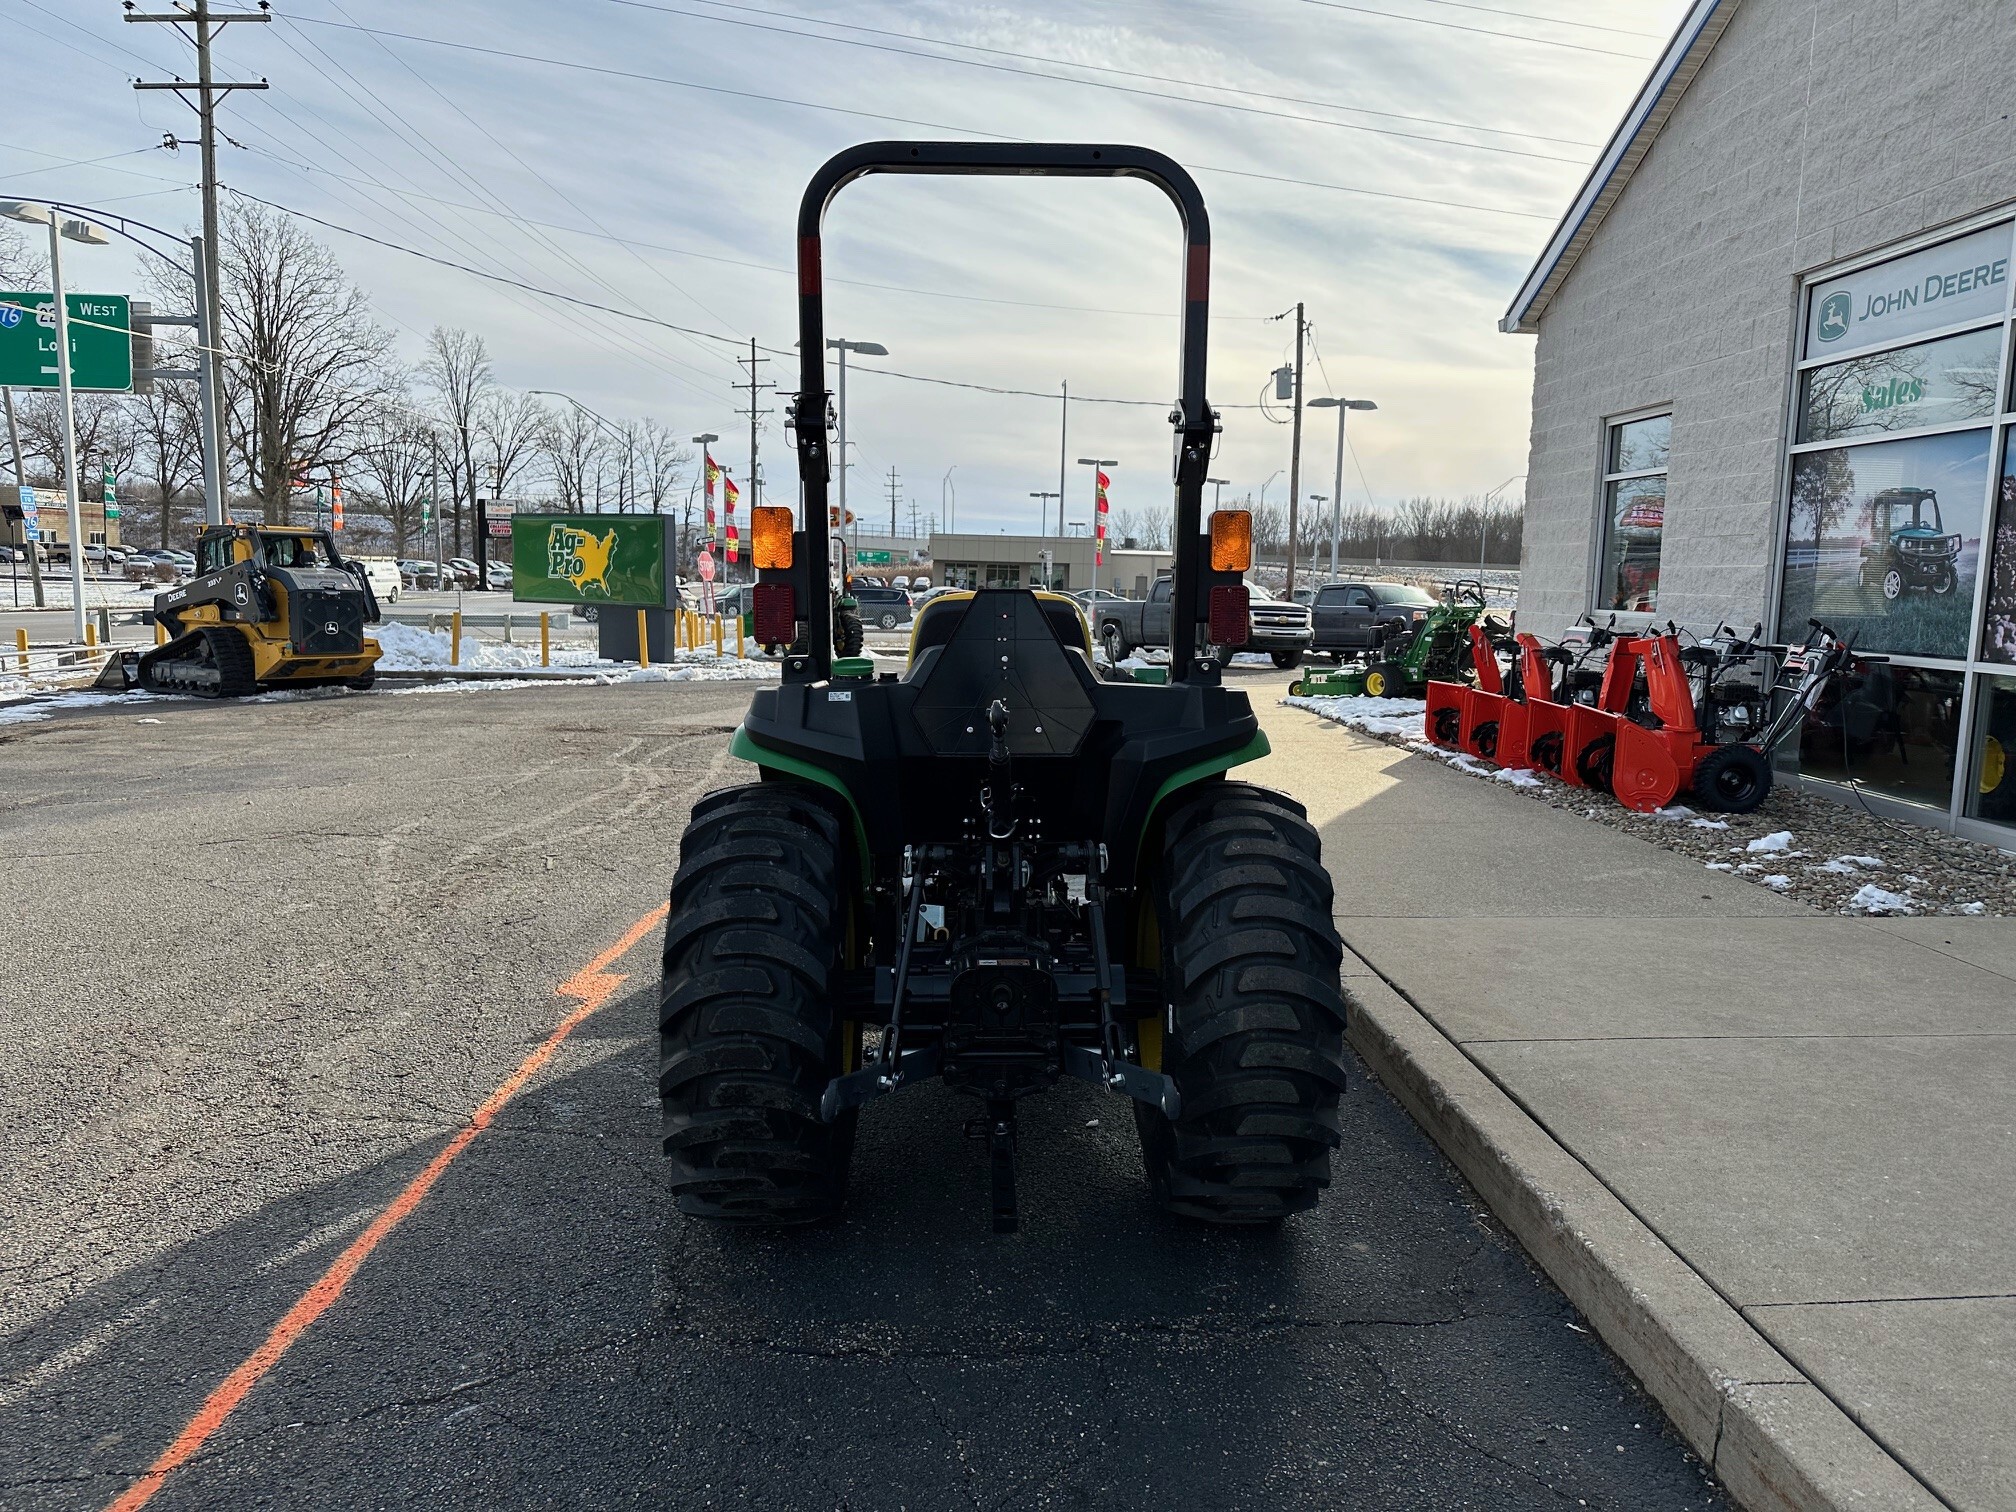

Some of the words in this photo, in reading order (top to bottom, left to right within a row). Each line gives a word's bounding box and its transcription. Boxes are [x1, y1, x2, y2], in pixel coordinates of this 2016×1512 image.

[1859, 285, 1919, 322] JOHN
[1924, 258, 2007, 303] DEERE
[0, 308, 19, 322] 76
[80, 303, 117, 316] WEST
[38, 337, 76, 352] Loi
[26, 516, 37, 526] 76
[550, 552, 584, 576] Pro
[700, 560, 714, 571] STOP
[167, 589, 187, 602] DEERE
